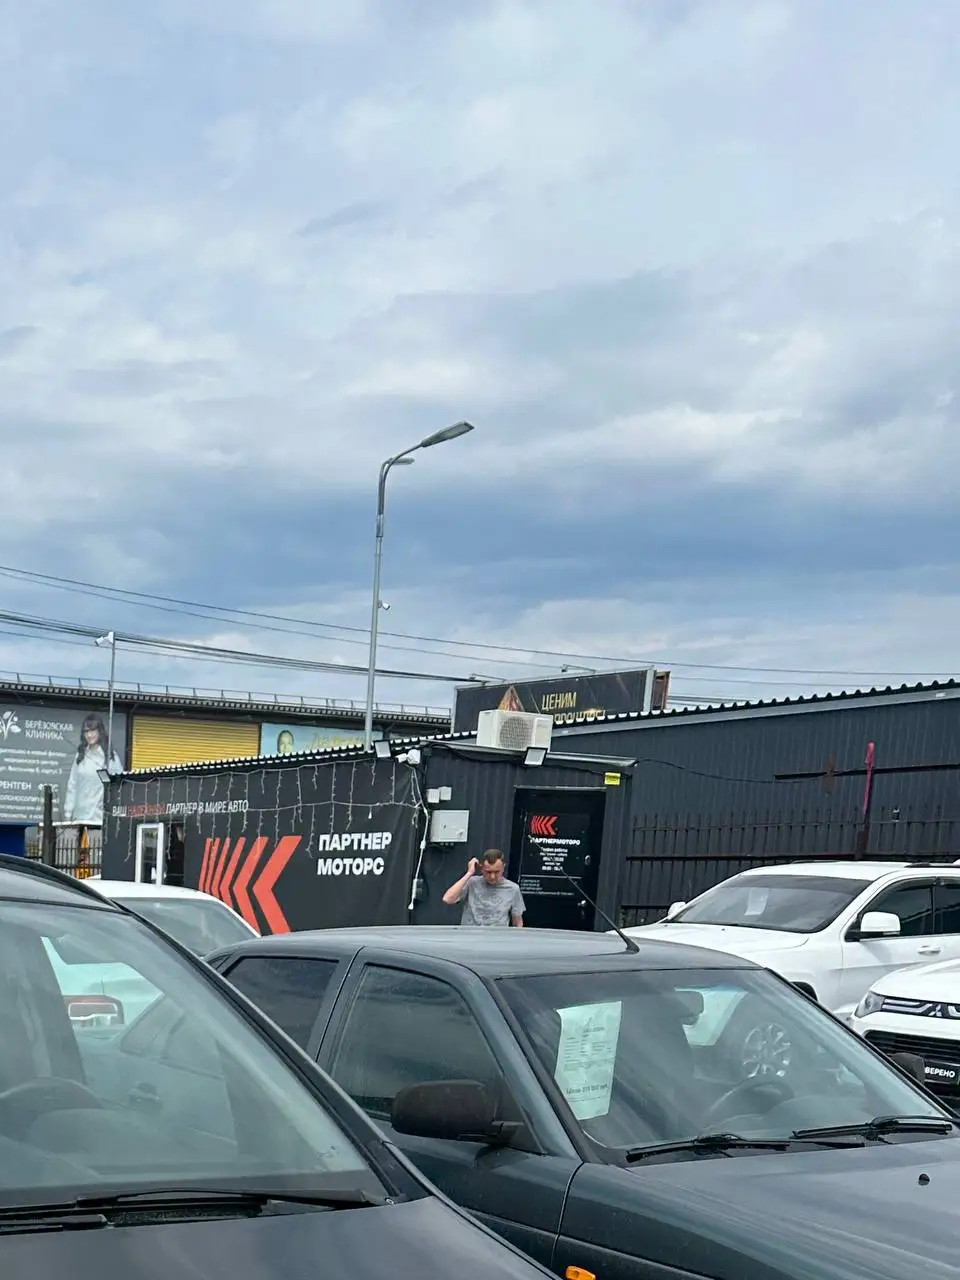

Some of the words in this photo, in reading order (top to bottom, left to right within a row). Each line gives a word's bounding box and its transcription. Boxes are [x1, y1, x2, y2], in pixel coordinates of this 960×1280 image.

[541, 692, 577, 711] ЦЕНИМ
[25, 730, 64, 740] КЛИНИКА
[112, 806, 127, 817] ВАШ
[166, 802, 198, 814] ПАРТНЕР
[198, 802, 204, 813] В
[205, 801, 227, 813] МИРЕ
[227, 800, 249, 812] АВТО
[318, 831, 392, 851] ПАРТНЕР
[317, 857, 384, 875] МОТОРС
[924, 1066, 956, 1078] ВЕРЕНО
